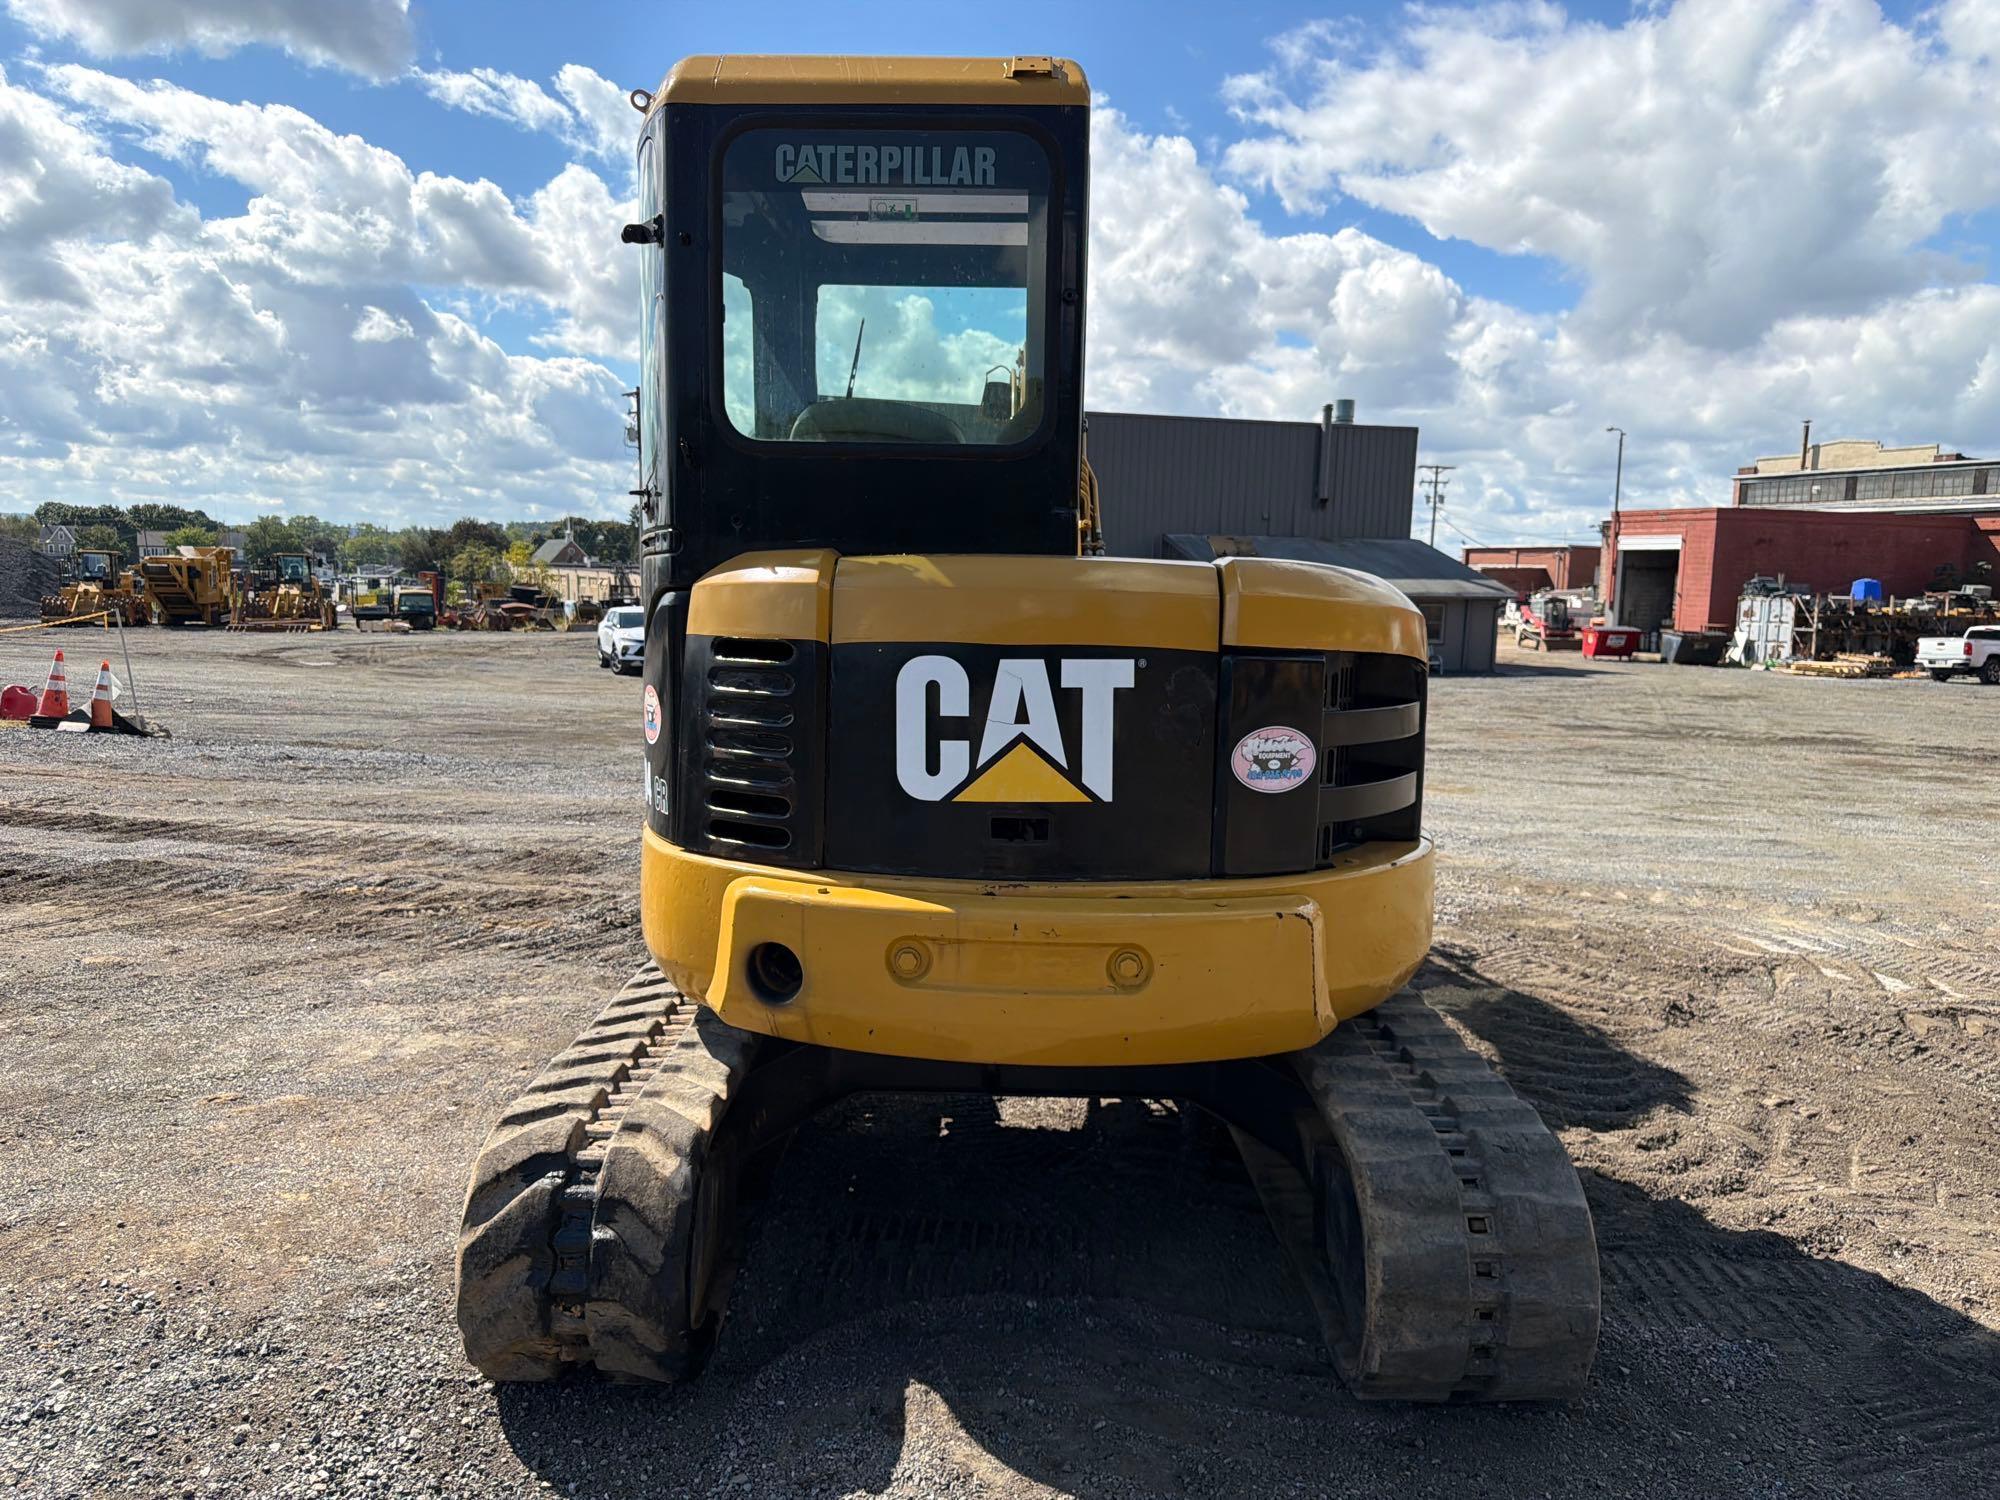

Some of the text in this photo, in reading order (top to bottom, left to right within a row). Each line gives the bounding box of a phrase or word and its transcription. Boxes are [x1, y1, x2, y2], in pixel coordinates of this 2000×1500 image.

[775, 143, 996, 186] CATERPILLAR
[895, 655, 1135, 803] CAT
[1258, 752, 1291, 760] EQUIPMENT
